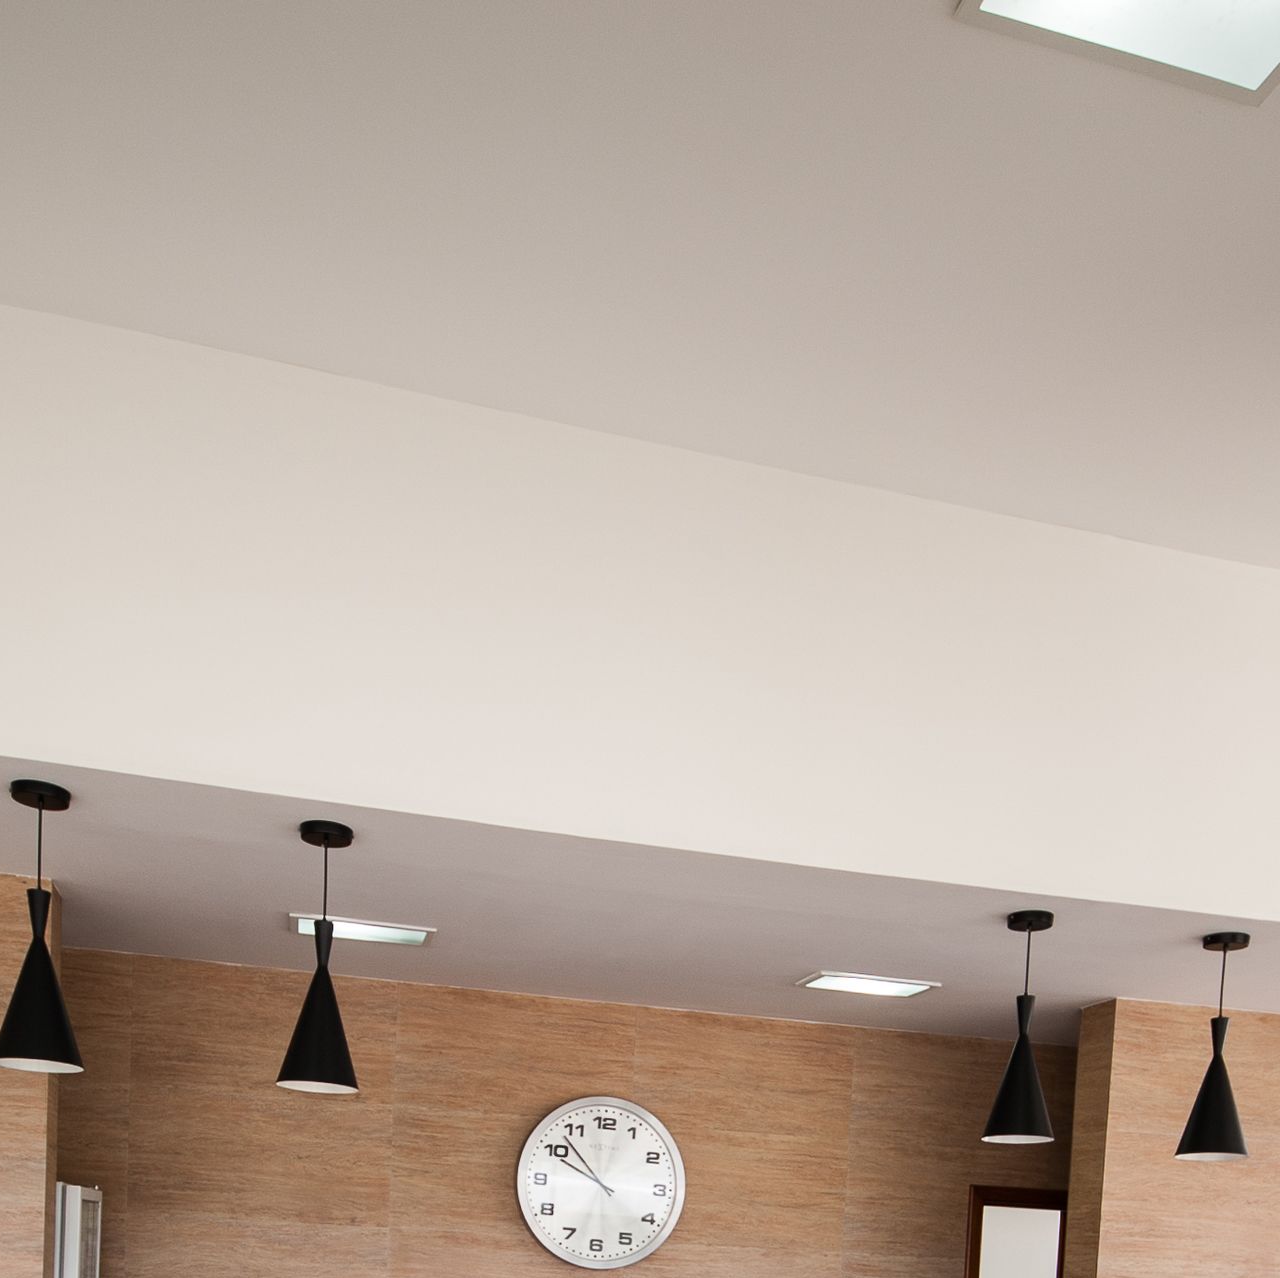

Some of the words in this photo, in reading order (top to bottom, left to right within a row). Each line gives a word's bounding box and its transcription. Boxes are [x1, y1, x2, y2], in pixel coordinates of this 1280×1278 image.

[593, 1116, 617, 1130] 12
[564, 1123, 585, 1137] 11
[627, 1127, 636, 1139] 1
[544, 1144, 568, 1157] 10
[646, 1152, 660, 1164] 2
[534, 1172, 547, 1185] 9
[653, 1184, 666, 1197] 3
[541, 1203, 554, 1215] 8
[641, 1213, 656, 1225] 4
[562, 1227, 576, 1239] 7
[619, 1233, 633, 1246] 5
[589, 1239, 603, 1252] 6
